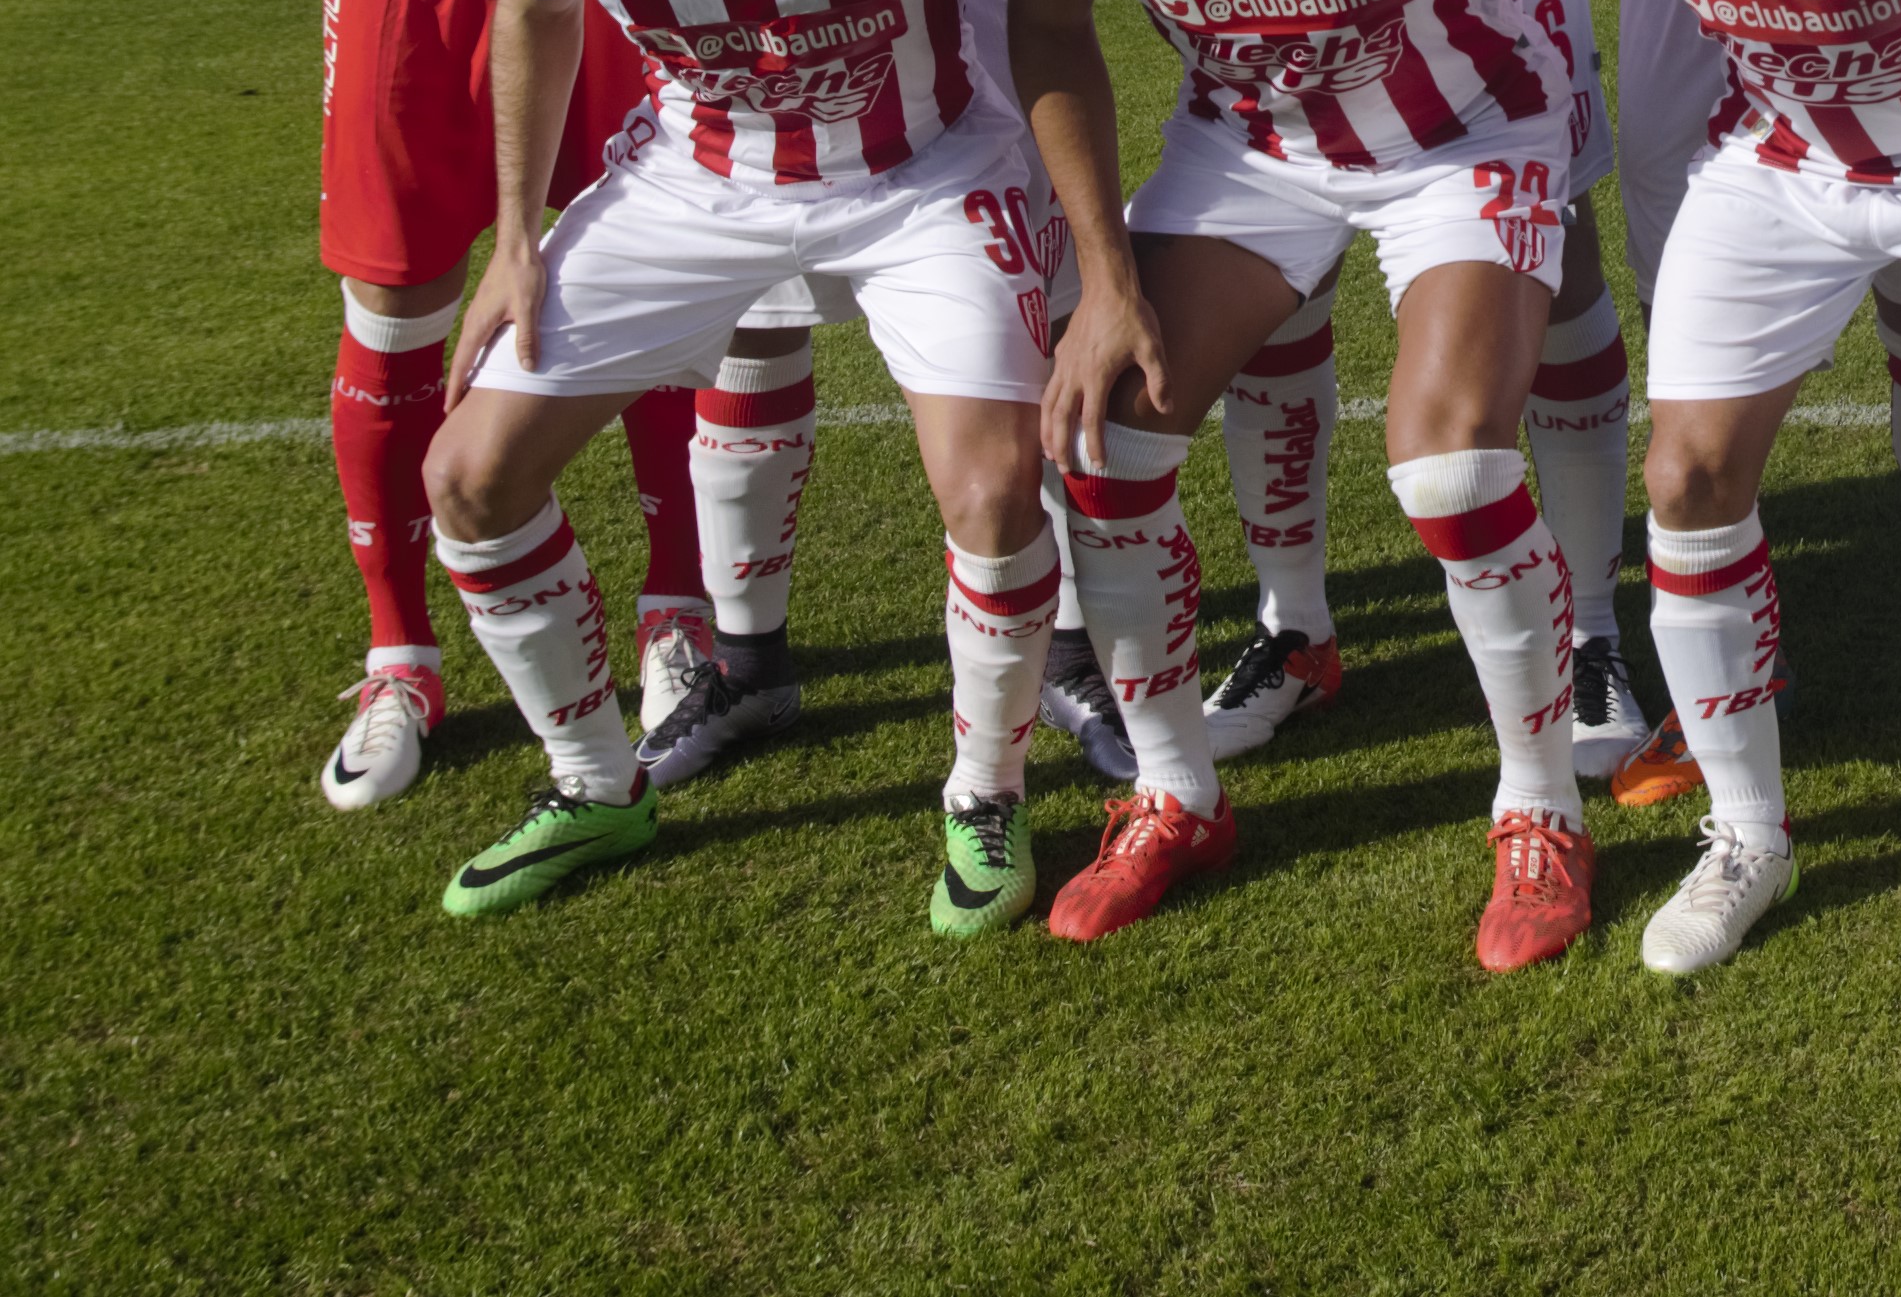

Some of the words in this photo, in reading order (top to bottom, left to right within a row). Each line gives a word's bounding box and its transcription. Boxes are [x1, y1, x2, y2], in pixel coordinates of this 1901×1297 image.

[696, 6, 897, 60] @clubaunion
[1473, 159, 1561, 227] 22
[963, 186, 1046, 278] 30
